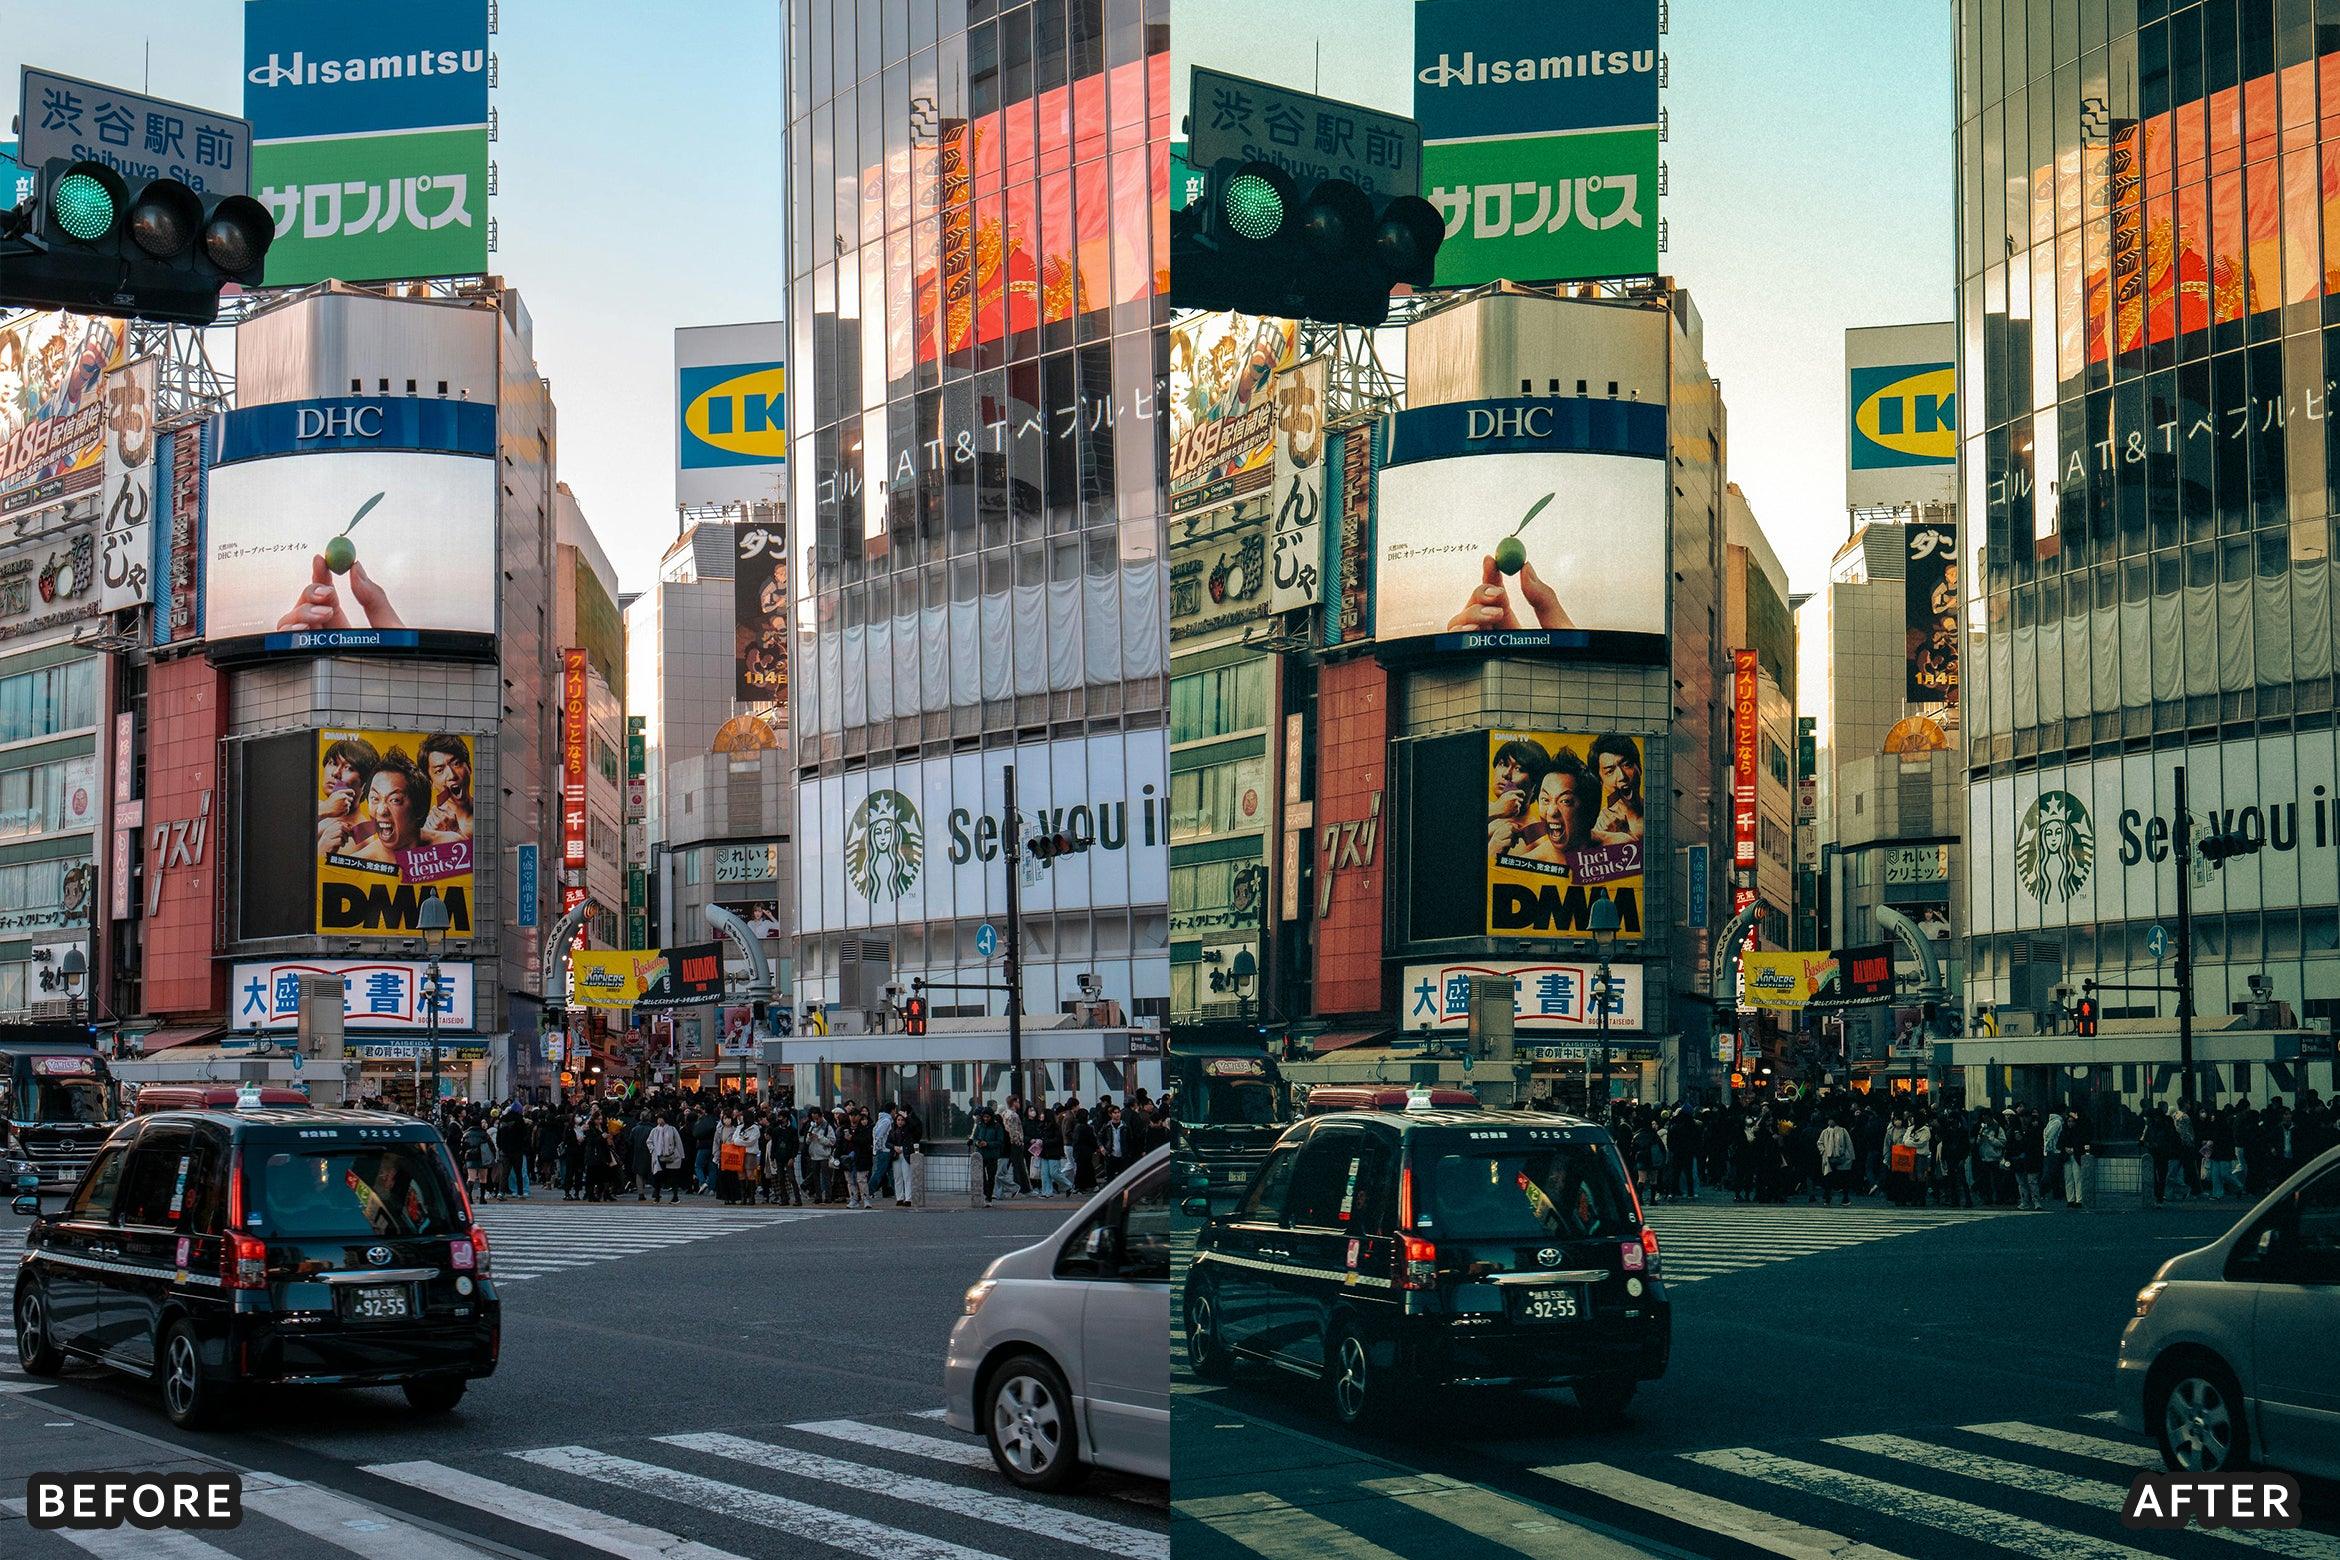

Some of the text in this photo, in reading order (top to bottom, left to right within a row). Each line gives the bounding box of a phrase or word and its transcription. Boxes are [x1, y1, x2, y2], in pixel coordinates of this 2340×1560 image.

[248, 49, 483, 87] Hisamitsu
[1418, 49, 1653, 87] Hisamitsu
[41, 88, 233, 171] 渋谷駅前
[1211, 88, 1403, 171] 渋谷駅前
[258, 174, 472, 239] サロンパス
[1428, 174, 1642, 239] サロンパス
[296, 405, 384, 440] DHC
[1466, 406, 1554, 441] DHC
[102, 369, 151, 600] もんじゃ
[1272, 370, 1321, 601] もんじゃ
[299, 632, 380, 647] DHC Channel
[1469, 633, 1550, 648] DHC Channel
[566, 655, 585, 859] クスリのことなら 三千里
[1737, 656, 1756, 860] クスリのことなら 三千里
[716, 865, 777, 881] クリニック
[731, 849, 777, 864] れいわ
[1887, 866, 1948, 882] クリニック
[1902, 850, 1948, 865] れいわ
[243, 972, 456, 1016] 大盛書店
[1413, 973, 1626, 1017] 大盛書店
[359, 1129, 402, 1139] 9255
[362, 1297, 407, 1317] 92-55
[1532, 1299, 1577, 1319] 92-55
